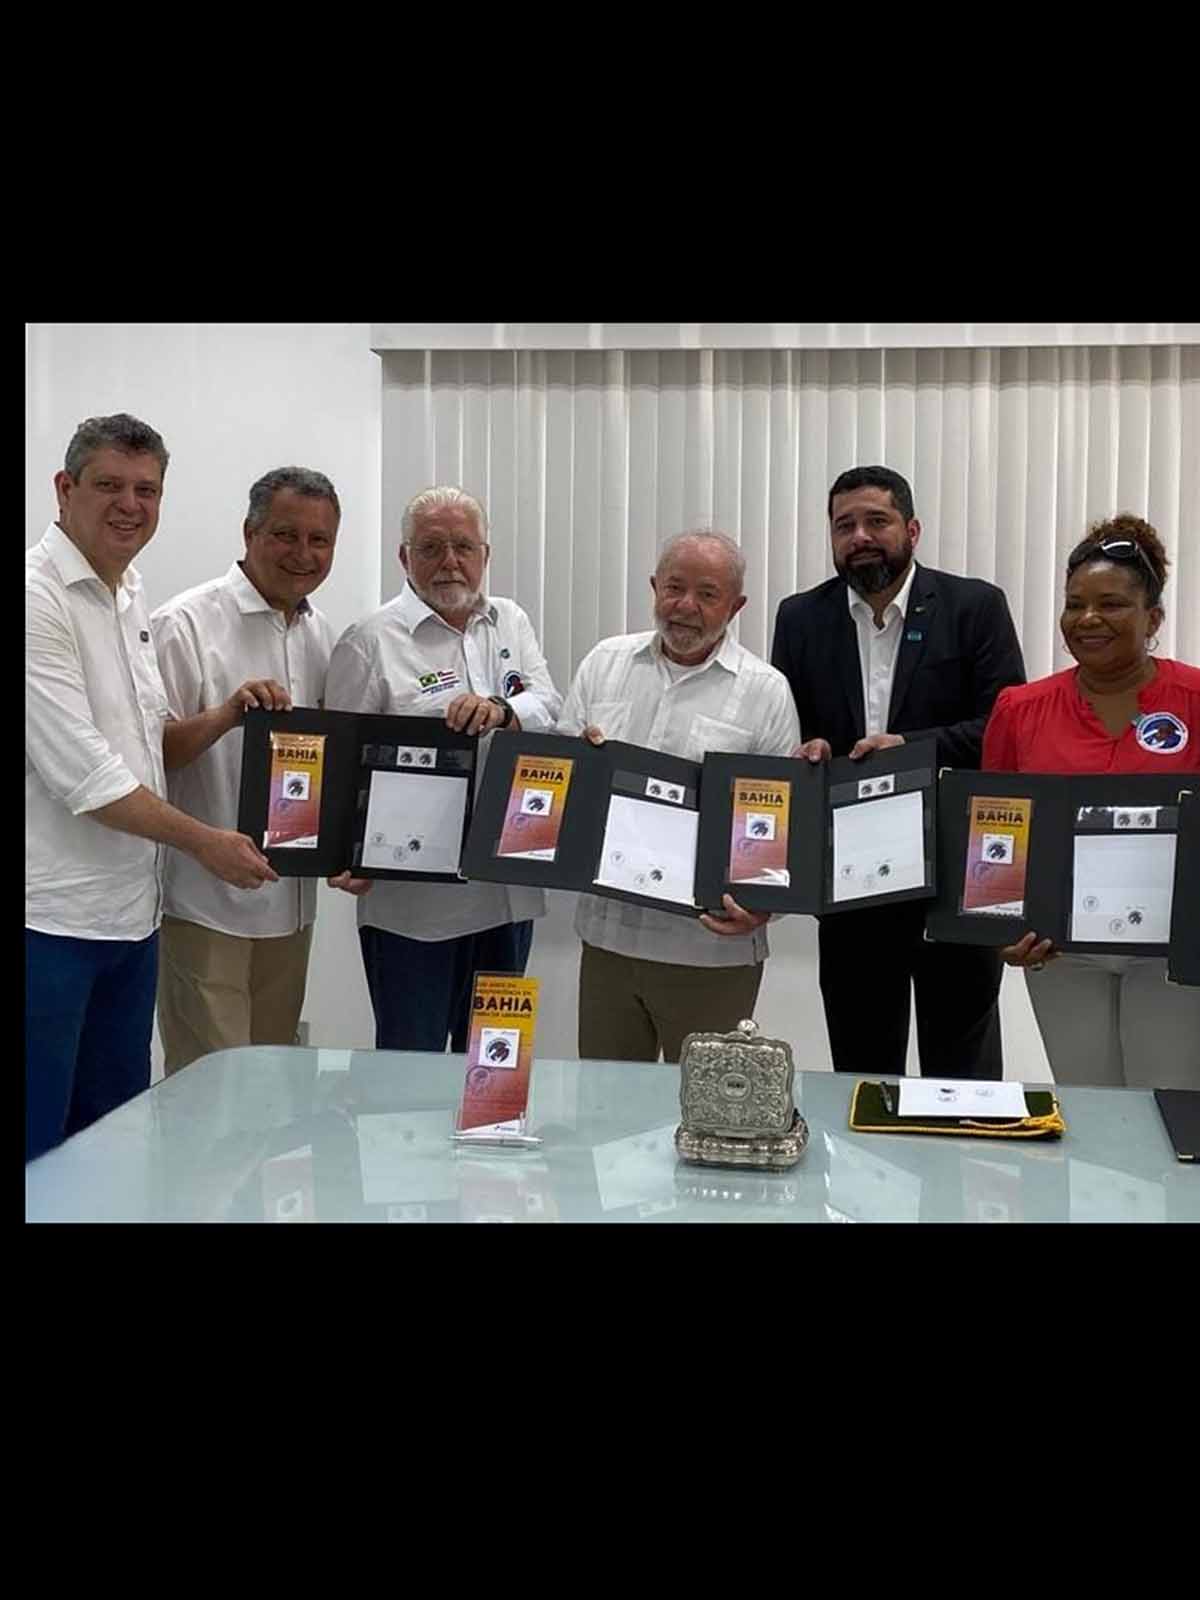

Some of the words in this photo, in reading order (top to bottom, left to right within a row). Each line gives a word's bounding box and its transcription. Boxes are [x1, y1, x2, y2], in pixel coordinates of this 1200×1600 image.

[278, 748, 318, 760] BAHIA
[521, 768, 564, 781] BAHIA
[739, 791, 784, 804] BAHIA
[977, 811, 1023, 823] BAHIA
[473, 995, 532, 1012] BAHIA
